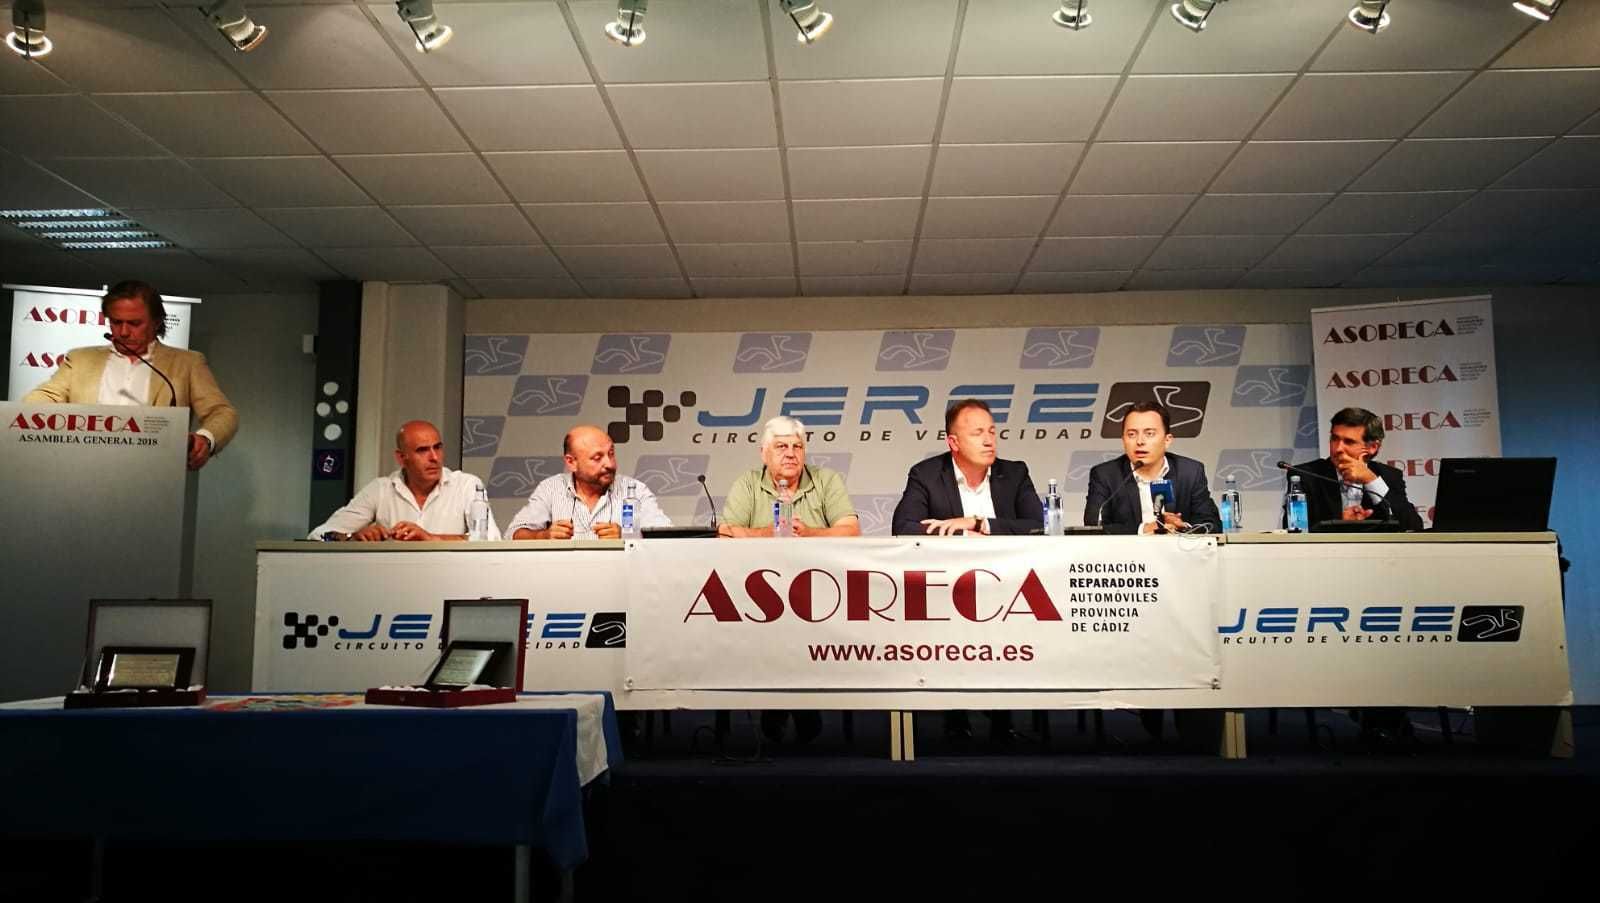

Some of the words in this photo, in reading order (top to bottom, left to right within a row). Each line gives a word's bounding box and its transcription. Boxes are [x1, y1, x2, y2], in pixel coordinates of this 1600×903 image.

[23, 306, 106, 326] ASOR
[1323, 319, 1454, 344] ASORECA
[1326, 365, 1458, 389] ASORECA
[697, 383, 1100, 428] JEREZ
[8, 412, 141, 433] ASORECA
[1383, 410, 1462, 432] RECA
[19, 433, 80, 444] ASAMBLEA
[83, 435, 134, 446] GENERAL
[136, 437, 158, 446] 2018
[692, 431, 836, 443] CIRCTO
[859, 430, 892, 441] DE
[915, 428, 1092, 441] VECIDAD
[1069, 560, 1146, 573] ASOCIACIÓN
[1069, 578, 1159, 588] REPARADORES
[683, 568, 1064, 623] ASORECA
[1070, 590, 1158, 602] AUTOMÓVILES
[1071, 607, 1139, 618] PROVINCIA
[1217, 605, 1455, 633] JEREZ
[1071, 622, 1087, 632] DE
[1093, 619, 1130, 632] CÁDIZ
[334, 642, 424, 650] CIRCUITO
[1223, 636, 1293, 645] RCUITO
[1342, 635, 1453, 643] VELOCIDAD
[808, 641, 1035, 662] www.asoreca.es
